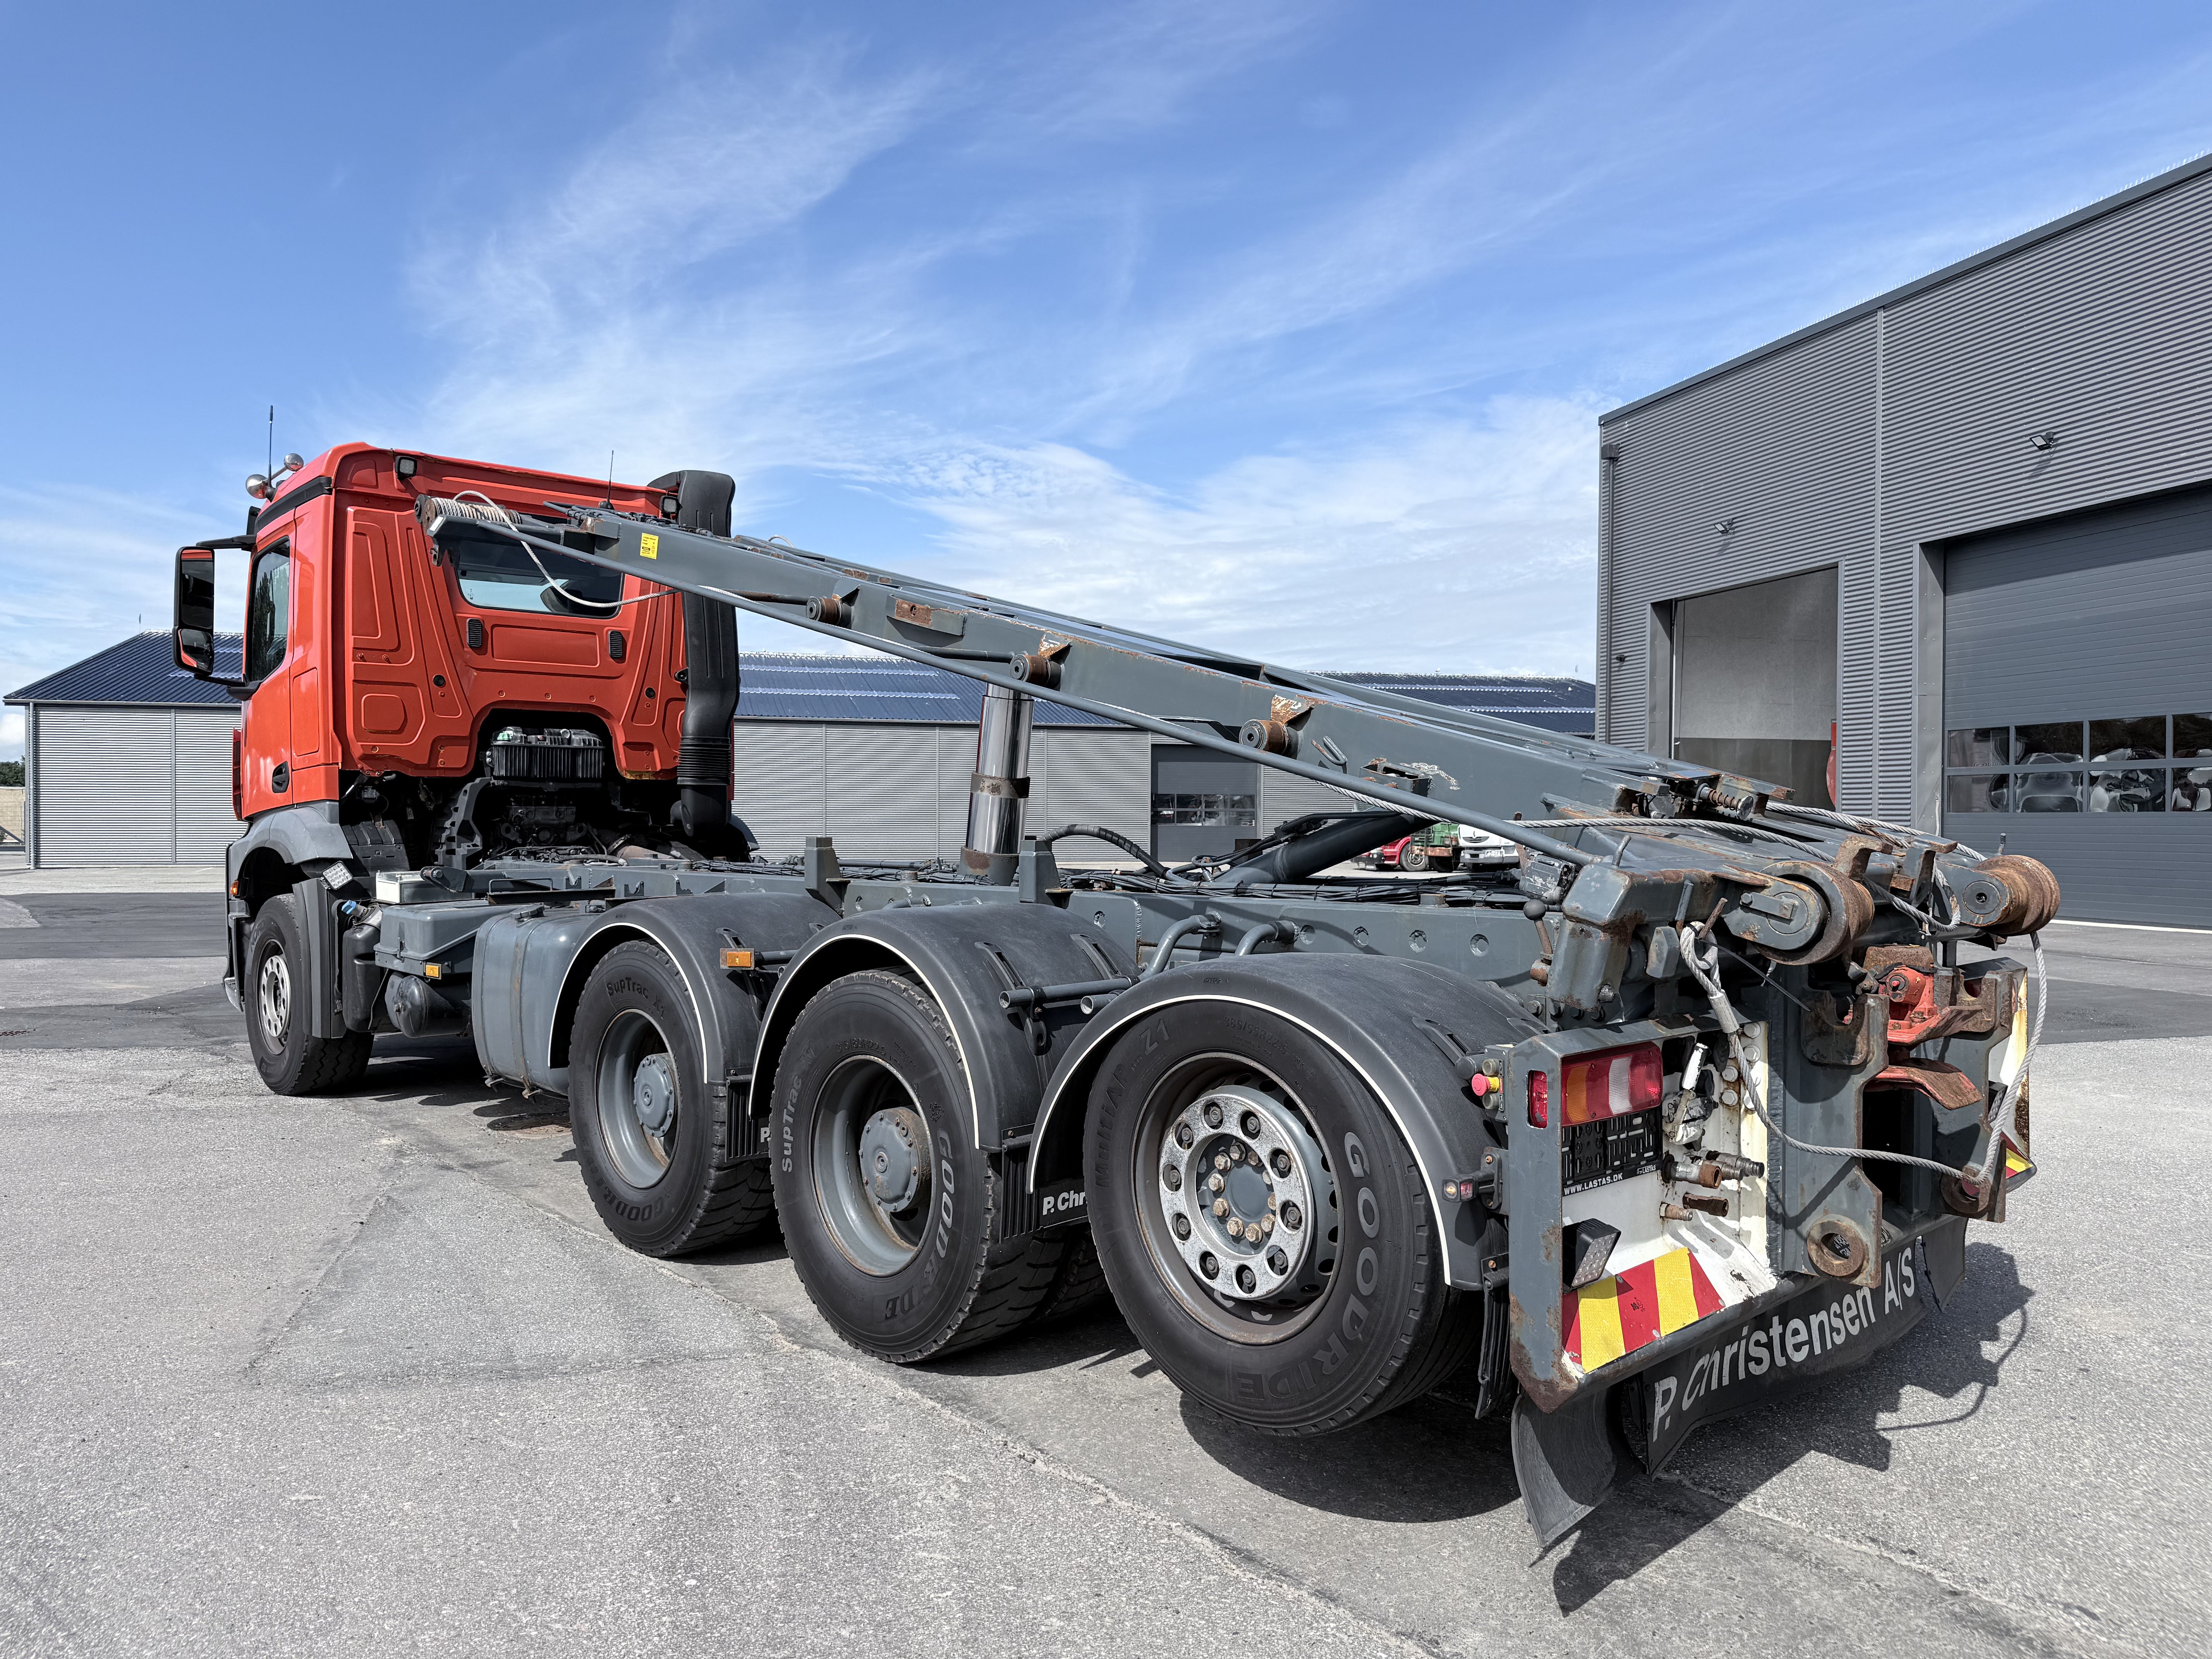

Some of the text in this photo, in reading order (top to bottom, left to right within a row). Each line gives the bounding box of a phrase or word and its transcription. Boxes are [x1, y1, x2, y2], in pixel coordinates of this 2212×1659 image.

[607, 977, 648, 999] SupTrac
[1139, 1018, 1169, 1055] Z1
[782, 1075, 802, 1173] SupTrac
[1564, 1173, 1623, 1195] WWW.LASTAS.DK
[1642, 1165, 1656, 1174] LASTAS
[1042, 1190, 1087, 1216] P. Chr
[1236, 1132, 1380, 1400] GOODRIDE
[1653, 1247, 1915, 1443] P. Christensen A/S
